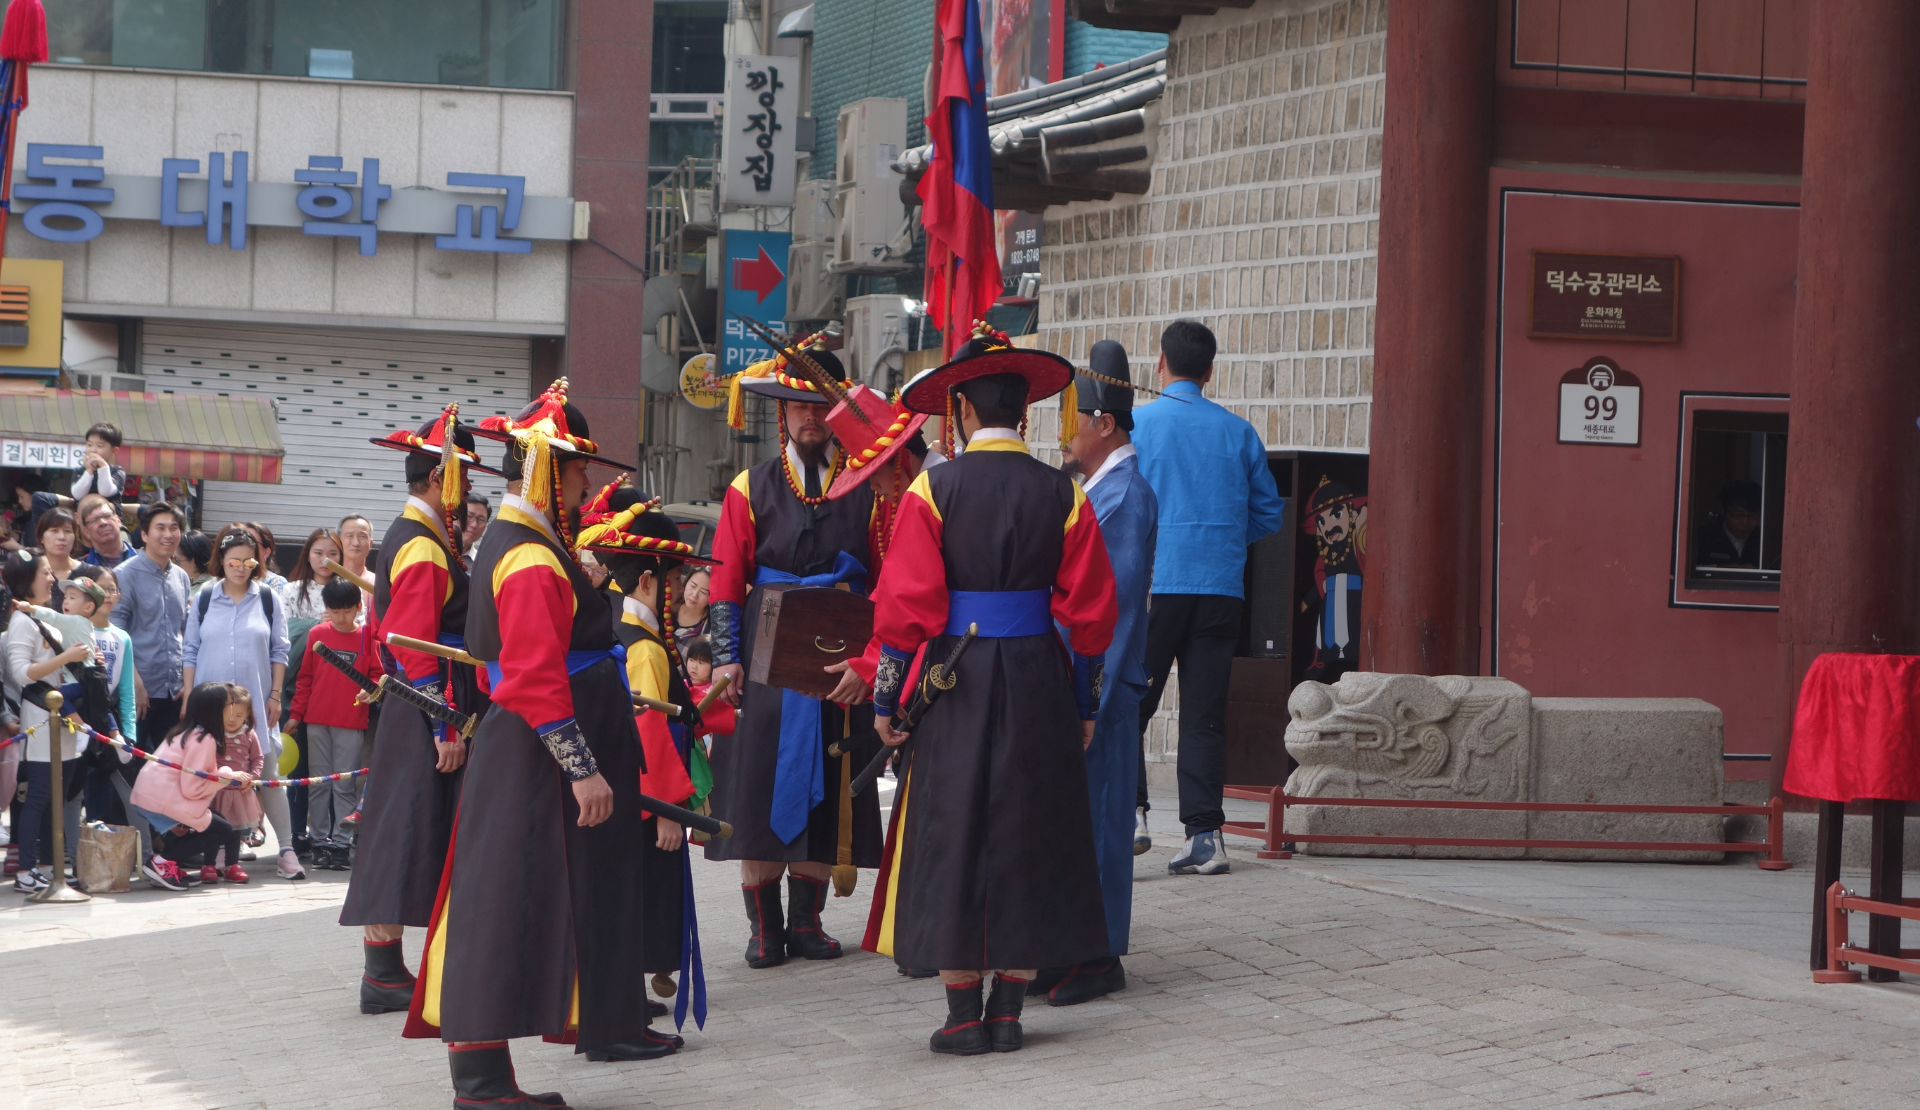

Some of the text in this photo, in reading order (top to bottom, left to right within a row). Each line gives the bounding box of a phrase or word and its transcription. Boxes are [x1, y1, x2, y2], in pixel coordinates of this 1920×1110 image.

[740, 65, 784, 192] 깡장집
[13, 142, 533, 257] 동대학교
[1546, 270, 1663, 296] 덕수궁관리소
[1585, 306, 1623, 319] 문화재청
[726, 347, 780, 366] PIZZ
[1584, 394, 1618, 421] 99
[1583, 424, 1616, 435] 세종대로
